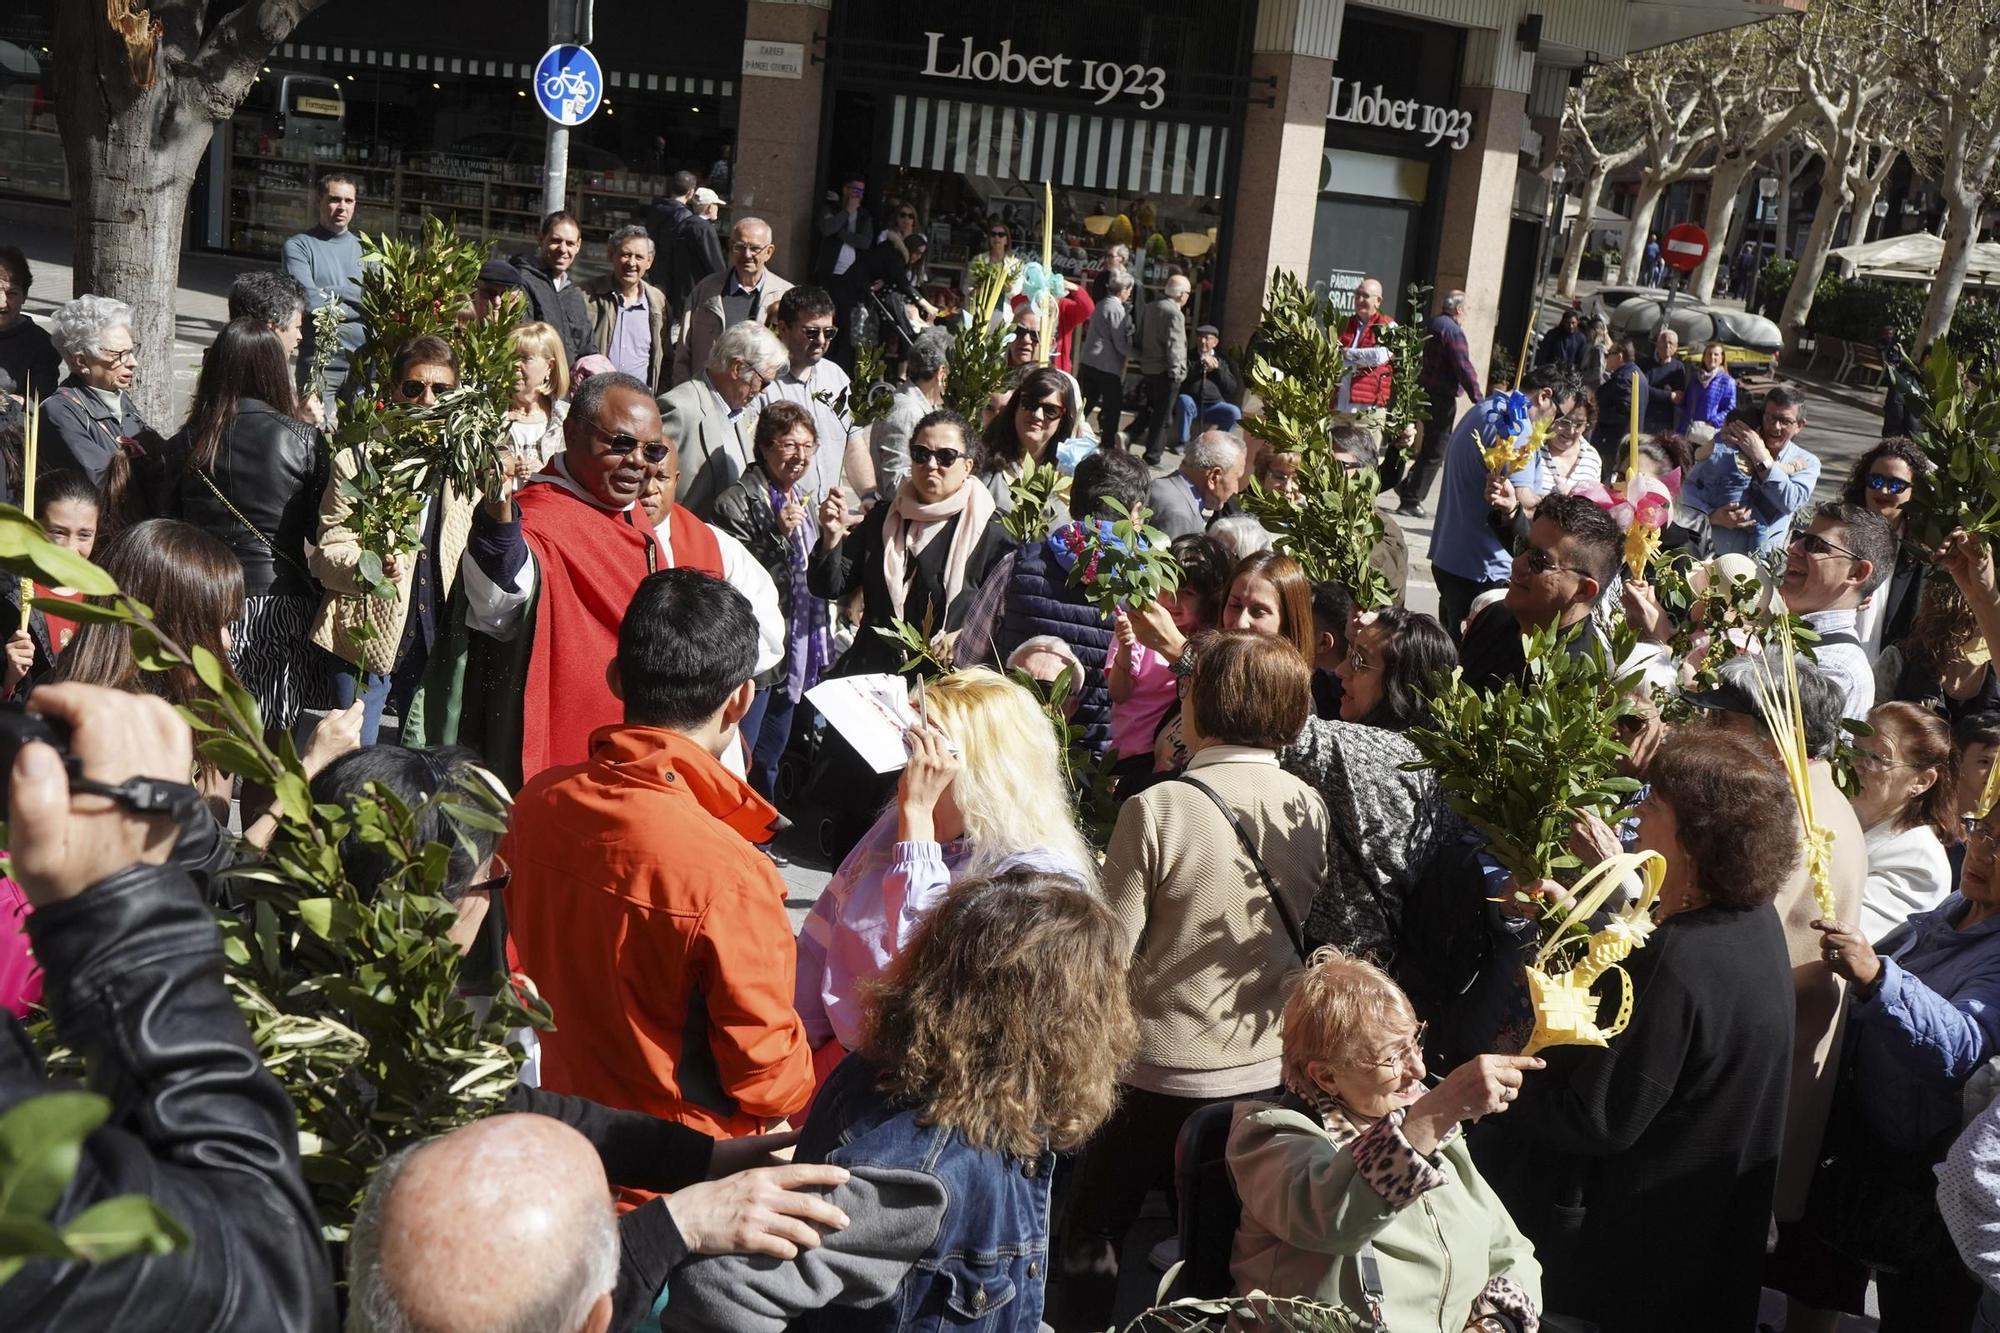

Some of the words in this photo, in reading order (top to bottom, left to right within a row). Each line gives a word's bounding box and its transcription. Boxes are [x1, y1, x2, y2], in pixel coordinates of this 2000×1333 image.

[920, 31, 1072, 88] Llobet
[1080, 60, 1166, 110] 1923
[1326, 77, 1419, 130] Llobet
[1419, 105, 1472, 150] 1923
